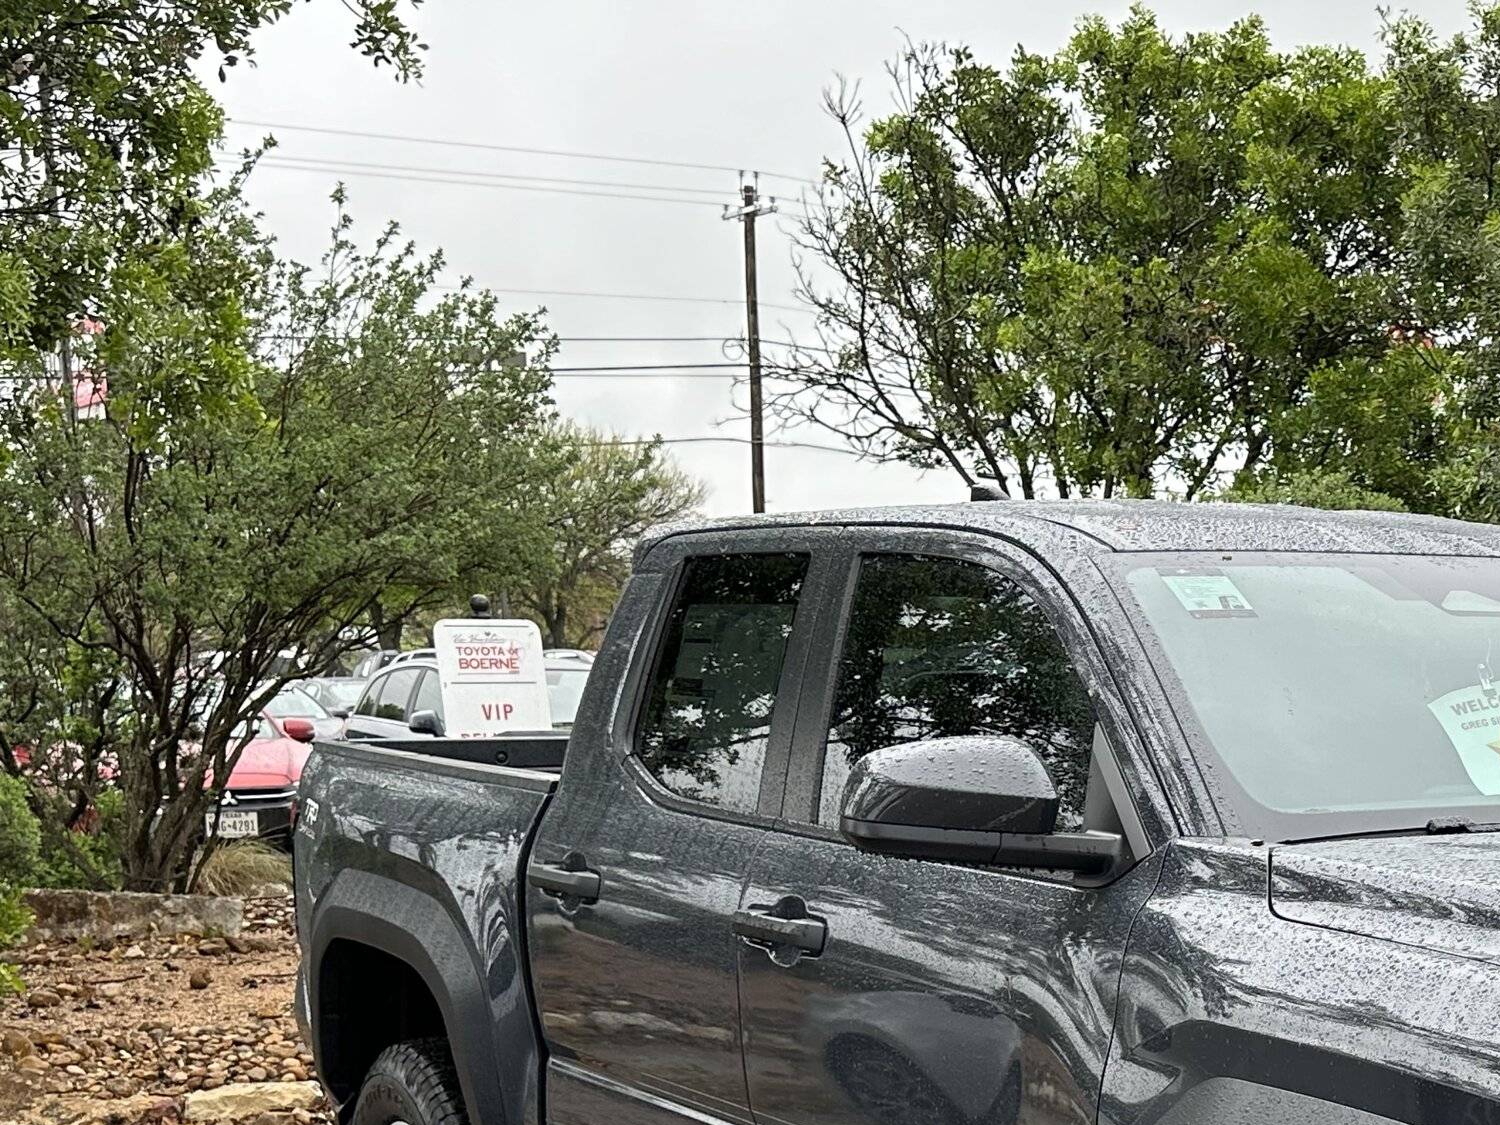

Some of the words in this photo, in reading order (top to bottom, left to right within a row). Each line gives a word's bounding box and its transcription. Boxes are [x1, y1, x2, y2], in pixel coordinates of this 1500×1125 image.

[455, 646, 505, 656] TOYOTA
[458, 658, 520, 670] BOERNE
[482, 703, 514, 721] VIP
[1460, 716, 1490, 731] GREG
